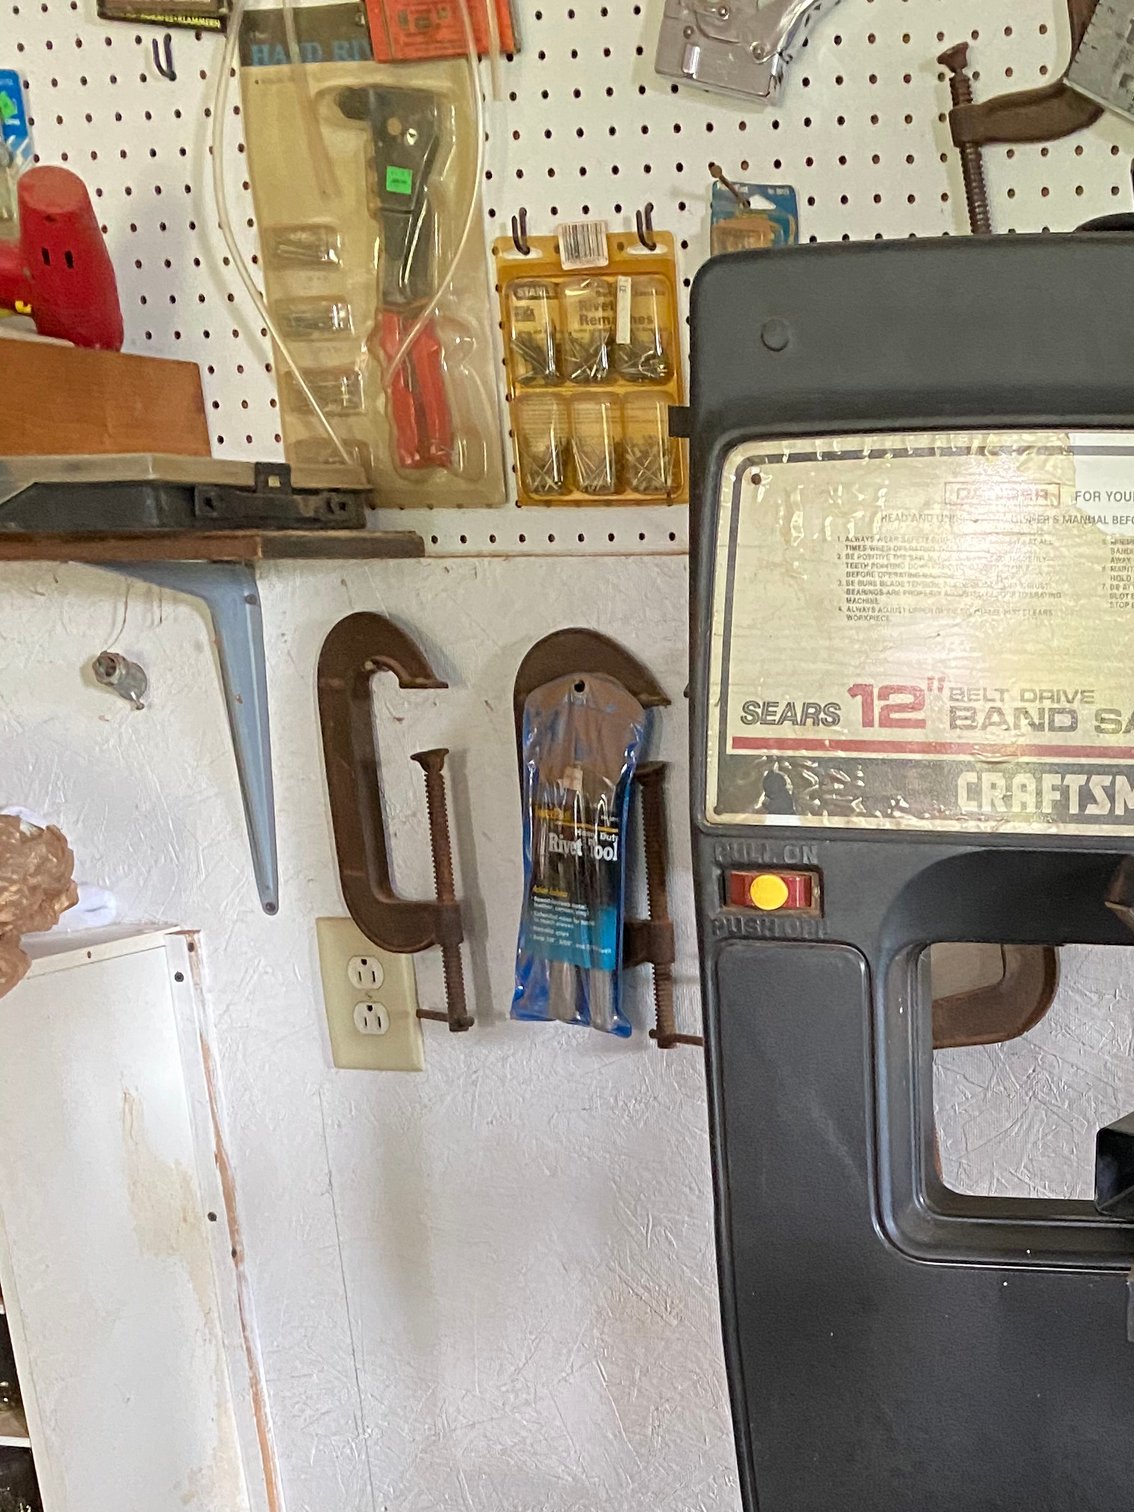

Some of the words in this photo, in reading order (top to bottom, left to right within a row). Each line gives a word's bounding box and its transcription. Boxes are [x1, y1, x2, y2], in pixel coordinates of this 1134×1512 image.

[252, 42, 321, 66] HAD
[1075, 490, 1101, 502] FOR
[1062, 515, 1109, 525] MANUAL
[950, 686, 1010, 704] BELT
[1019, 687, 1095, 705] DRIVE
[740, 699, 842, 727] SEARS
[949, 705, 1078, 733] BAND
[783, 844, 818, 864] ON
